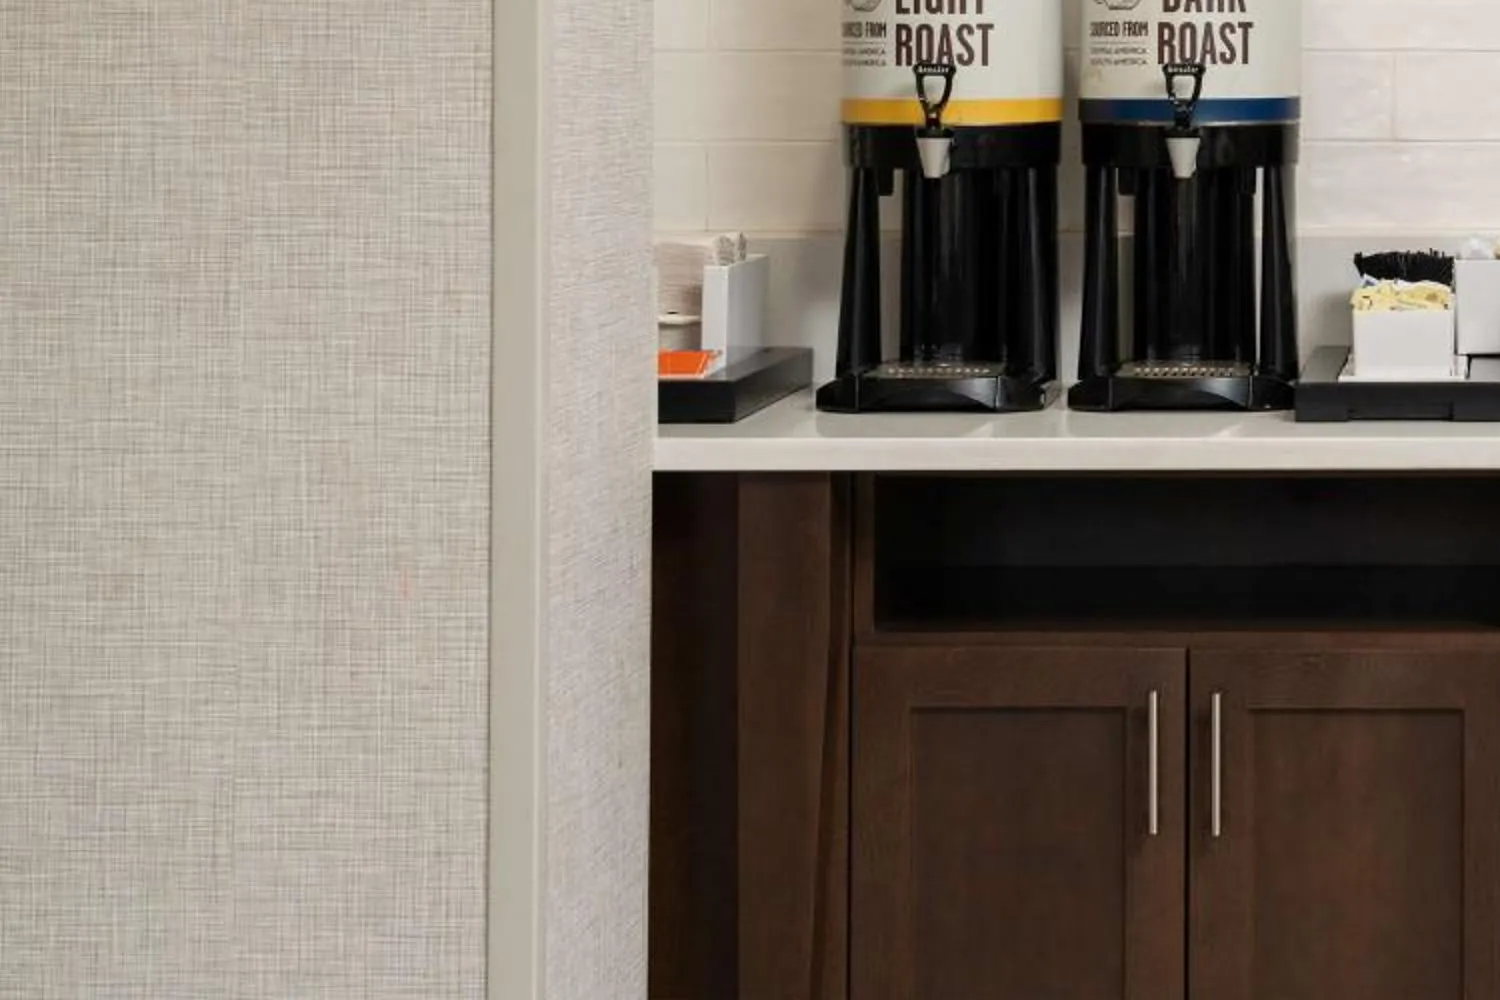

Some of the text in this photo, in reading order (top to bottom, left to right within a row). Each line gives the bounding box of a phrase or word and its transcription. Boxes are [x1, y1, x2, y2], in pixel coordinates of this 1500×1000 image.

[895, 23, 994, 67] ROAST
[1122, 21, 1149, 36] FROM
[1157, 21, 1254, 65] ROAST
